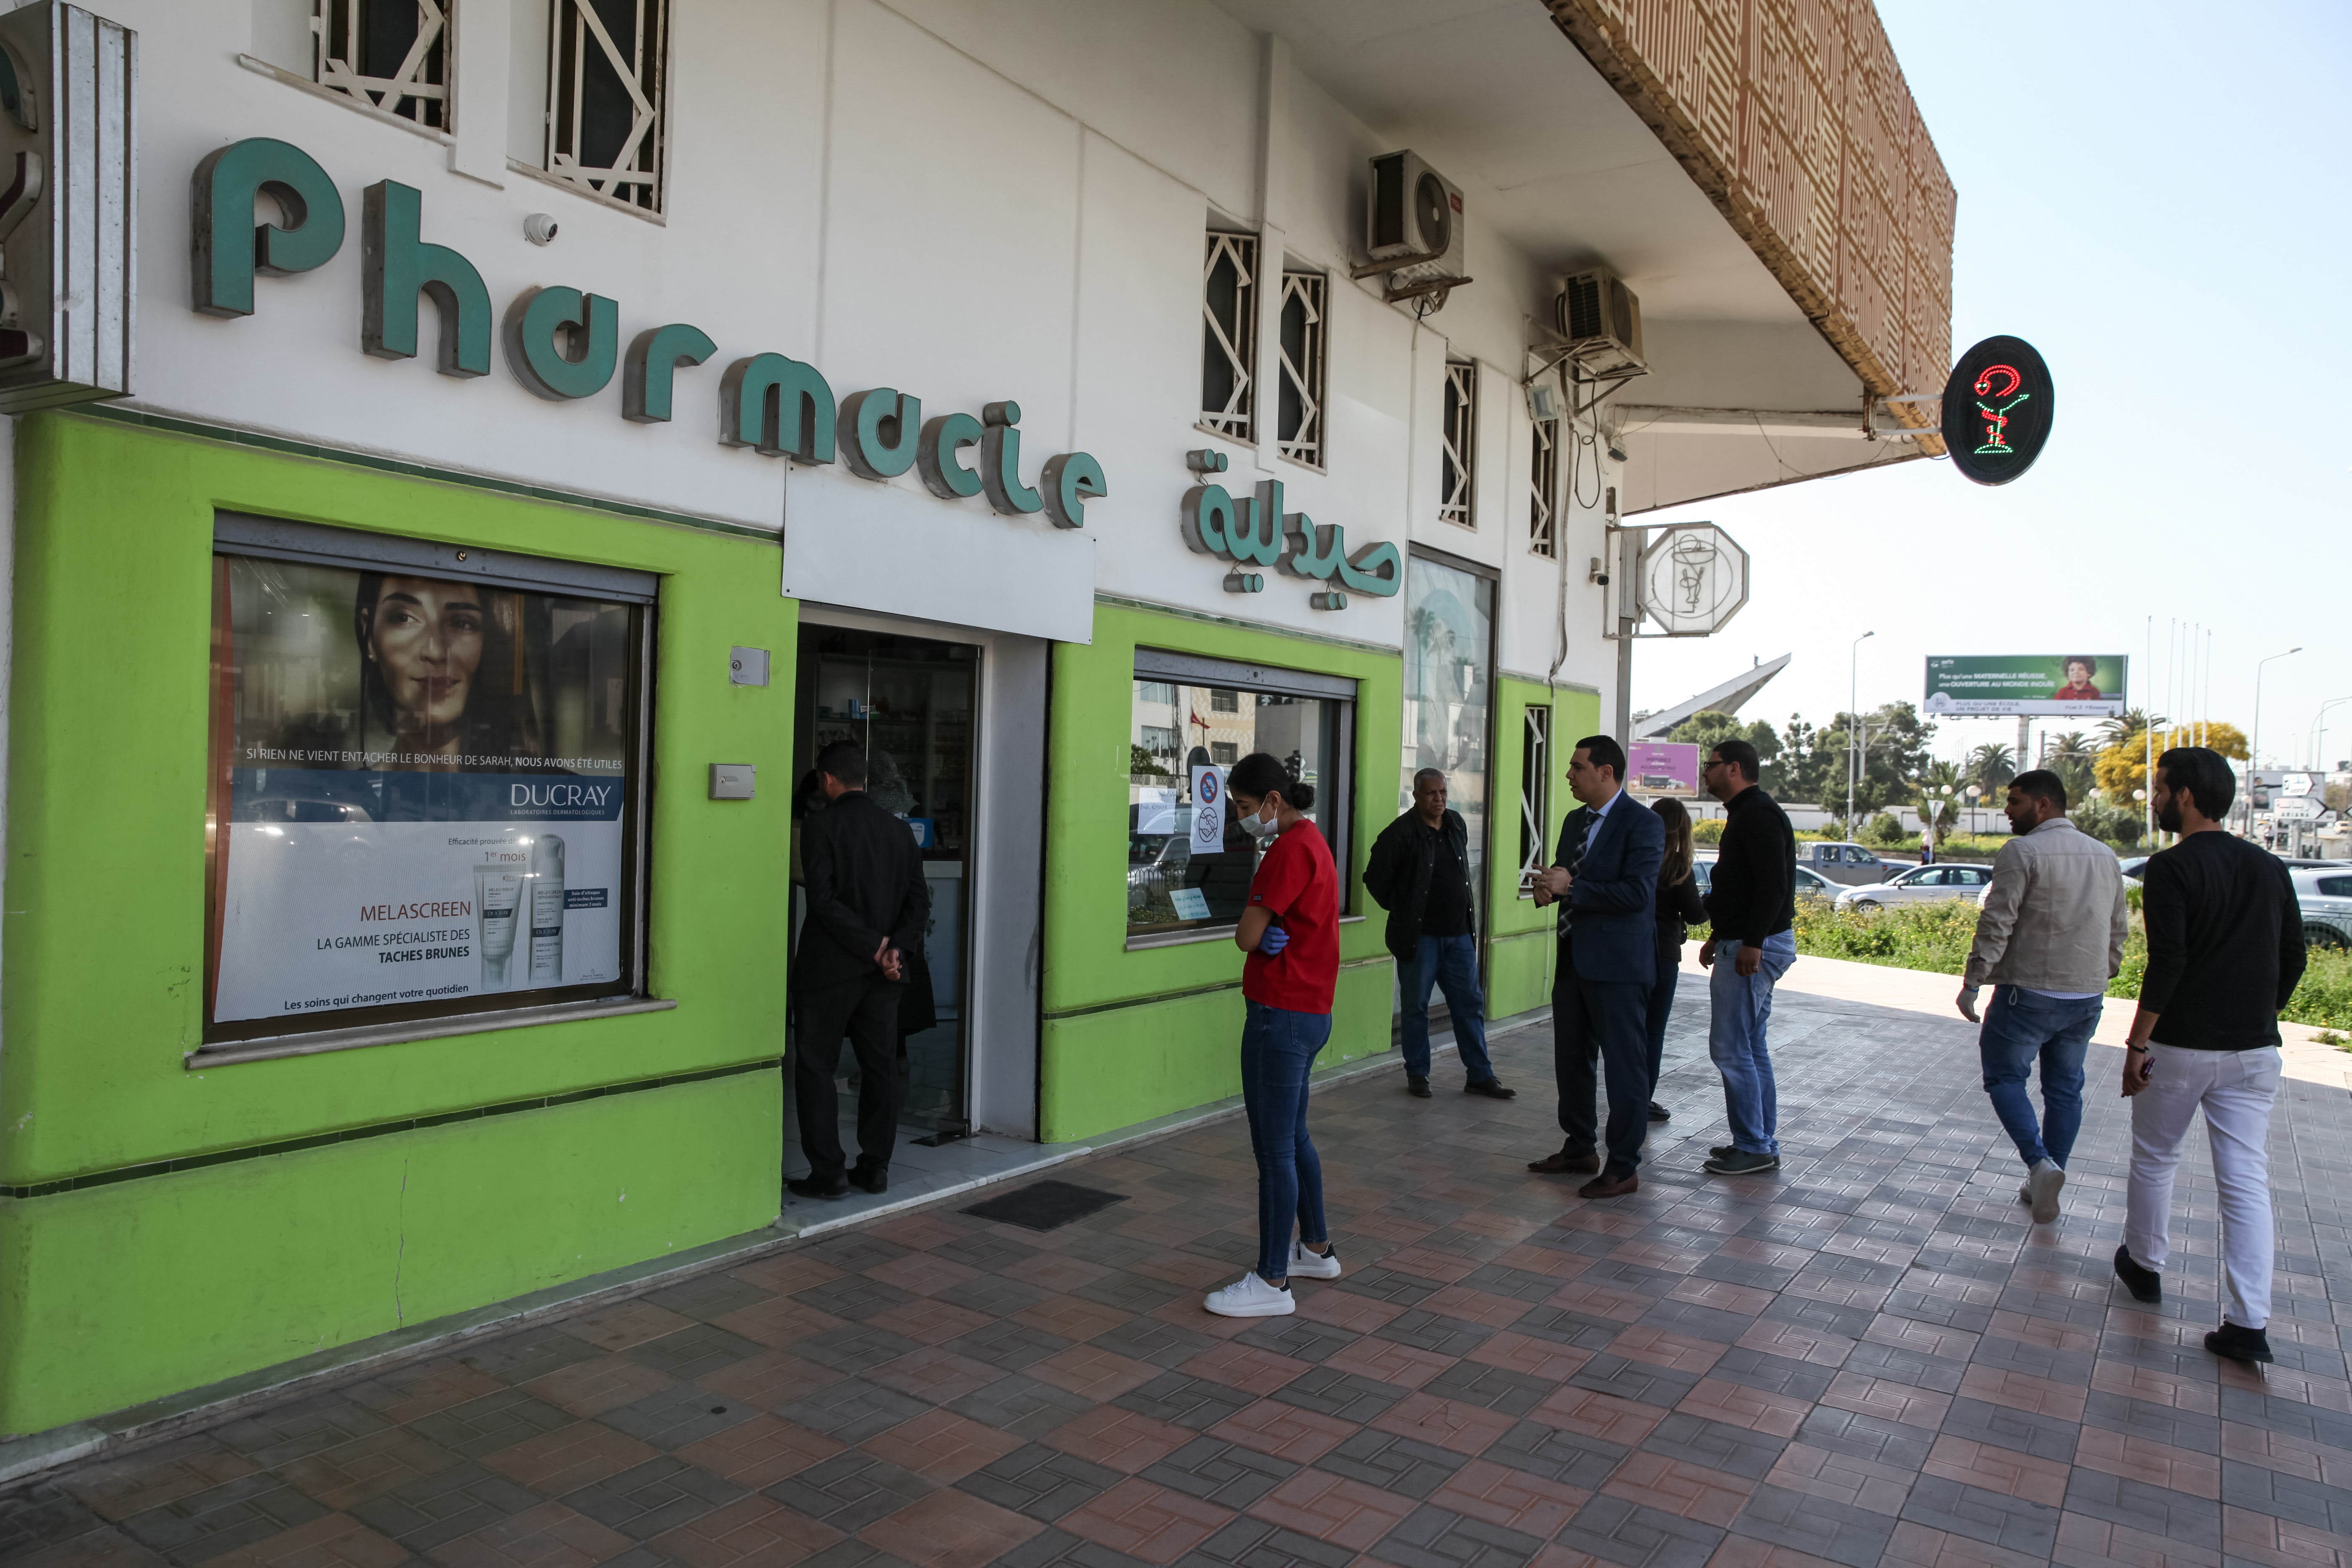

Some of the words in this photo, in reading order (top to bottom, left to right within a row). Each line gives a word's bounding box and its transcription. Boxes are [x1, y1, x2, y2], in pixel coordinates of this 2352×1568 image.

[191, 137, 1108, 529] Pharmacie
[1180, 448, 1402, 611] صيدلية
[247, 748, 256, 759] SI
[260, 749, 286, 760] RIEN
[289, 750, 304, 761] NE
[307, 750, 338, 761] VIENT
[342, 751, 397, 763] ENTACHER
[400, 753, 411, 763] LE
[414, 754, 462, 764] BONHEUR
[465, 756, 477, 765] DE
[480, 756, 513, 767] SARAH,
[516, 757, 542, 766] NOUS
[544, 758, 575, 768] AVONS
[577, 758, 592, 768] ÉTÉ
[594, 760, 622, 769] UTILES
[511, 784, 611, 806] DUCRAY
[480, 838, 507, 846] prouvée
[485, 851, 497, 862] 1er
[500, 851, 526, 861] mois
[361, 901, 471, 921] MELASCREEN
[317, 938, 332, 950] LA
[335, 935, 380, 949] GAMME
[383, 930, 447, 945] SPÉCIALISTE
[451, 929, 470, 941] DES
[379, 949, 423, 963] TACHES
[426, 946, 469, 960] BRUNES
[284, 1000, 302, 1010] Les
[304, 998, 330, 1008] soins
[333, 995, 349, 1007] qui
[352, 991, 397, 1003] changent
[400, 989, 423, 998] votre
[426, 984, 469, 997] quotidien
